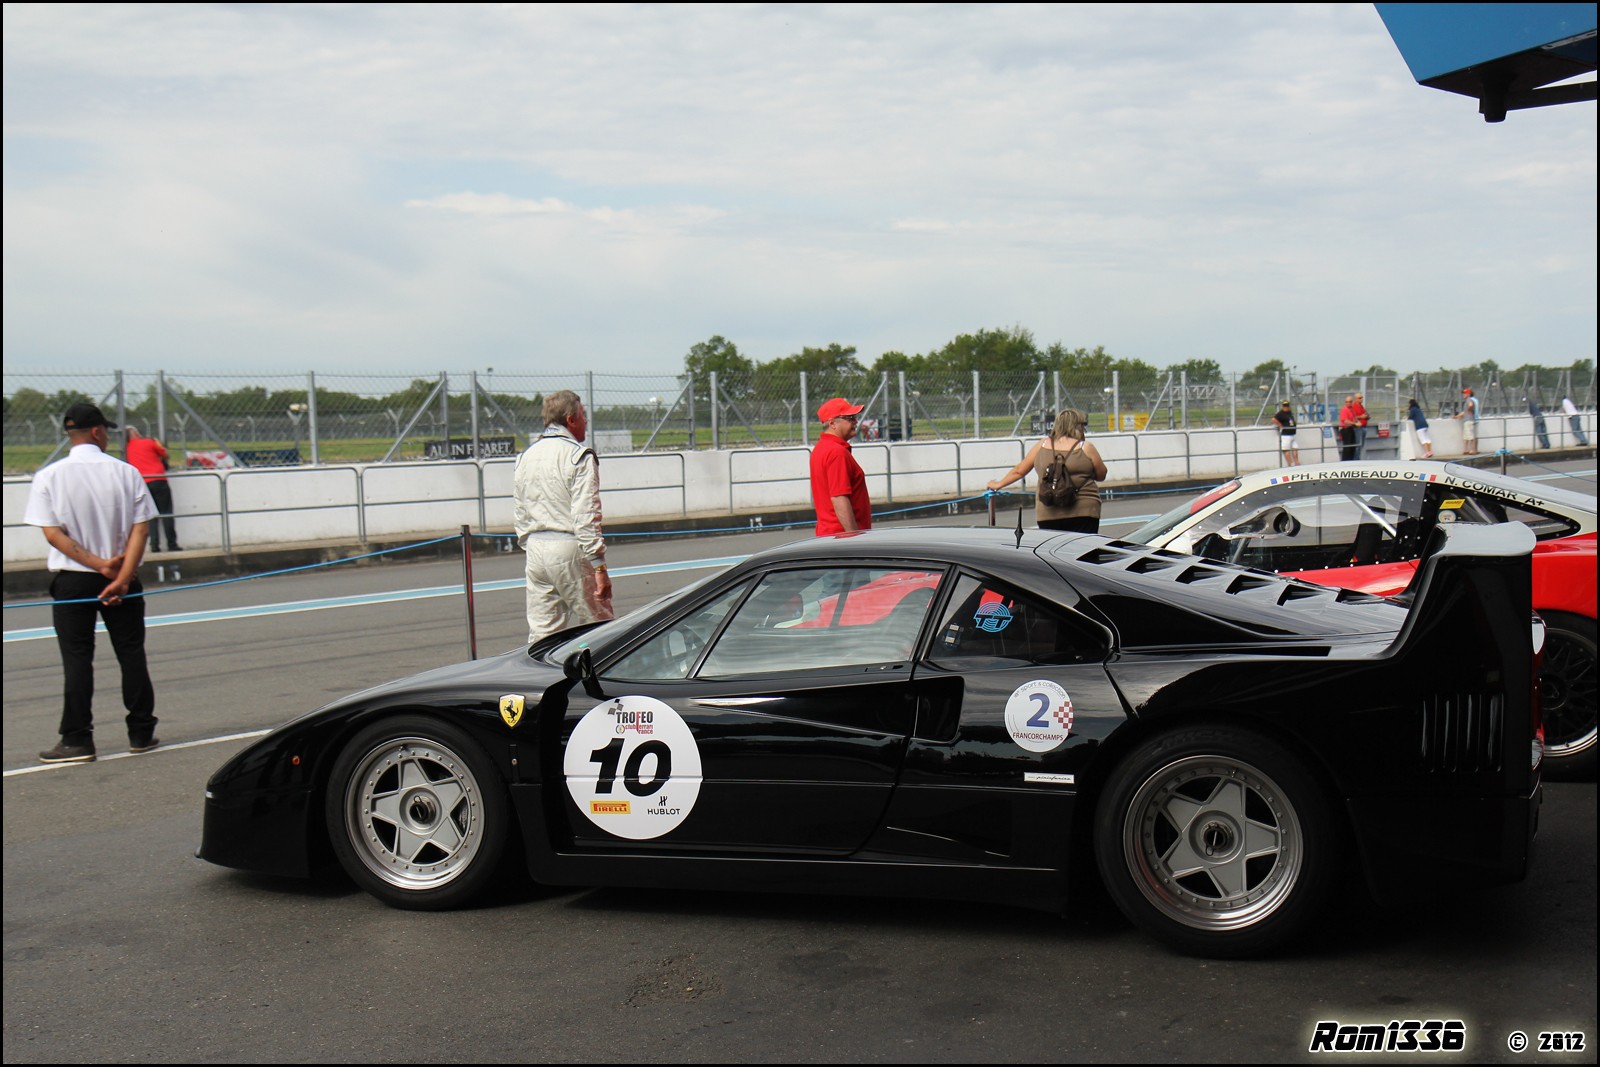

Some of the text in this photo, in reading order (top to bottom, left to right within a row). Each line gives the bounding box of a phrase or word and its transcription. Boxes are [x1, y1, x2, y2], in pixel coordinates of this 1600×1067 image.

[466, 442, 511, 455] FGARET
[1291, 472, 1313, 480] PH.
[1318, 470, 1398, 479] RAMBEAUD
[1445, 477, 1546, 507] N. COMAR A+
[1026, 693, 1050, 727] 2
[616, 711, 653, 724] TROFEO
[1012, 732, 1064, 741] FRANCORCHAMPS
[590, 738, 671, 796] 10
[593, 804, 627, 812] PIRELLI
